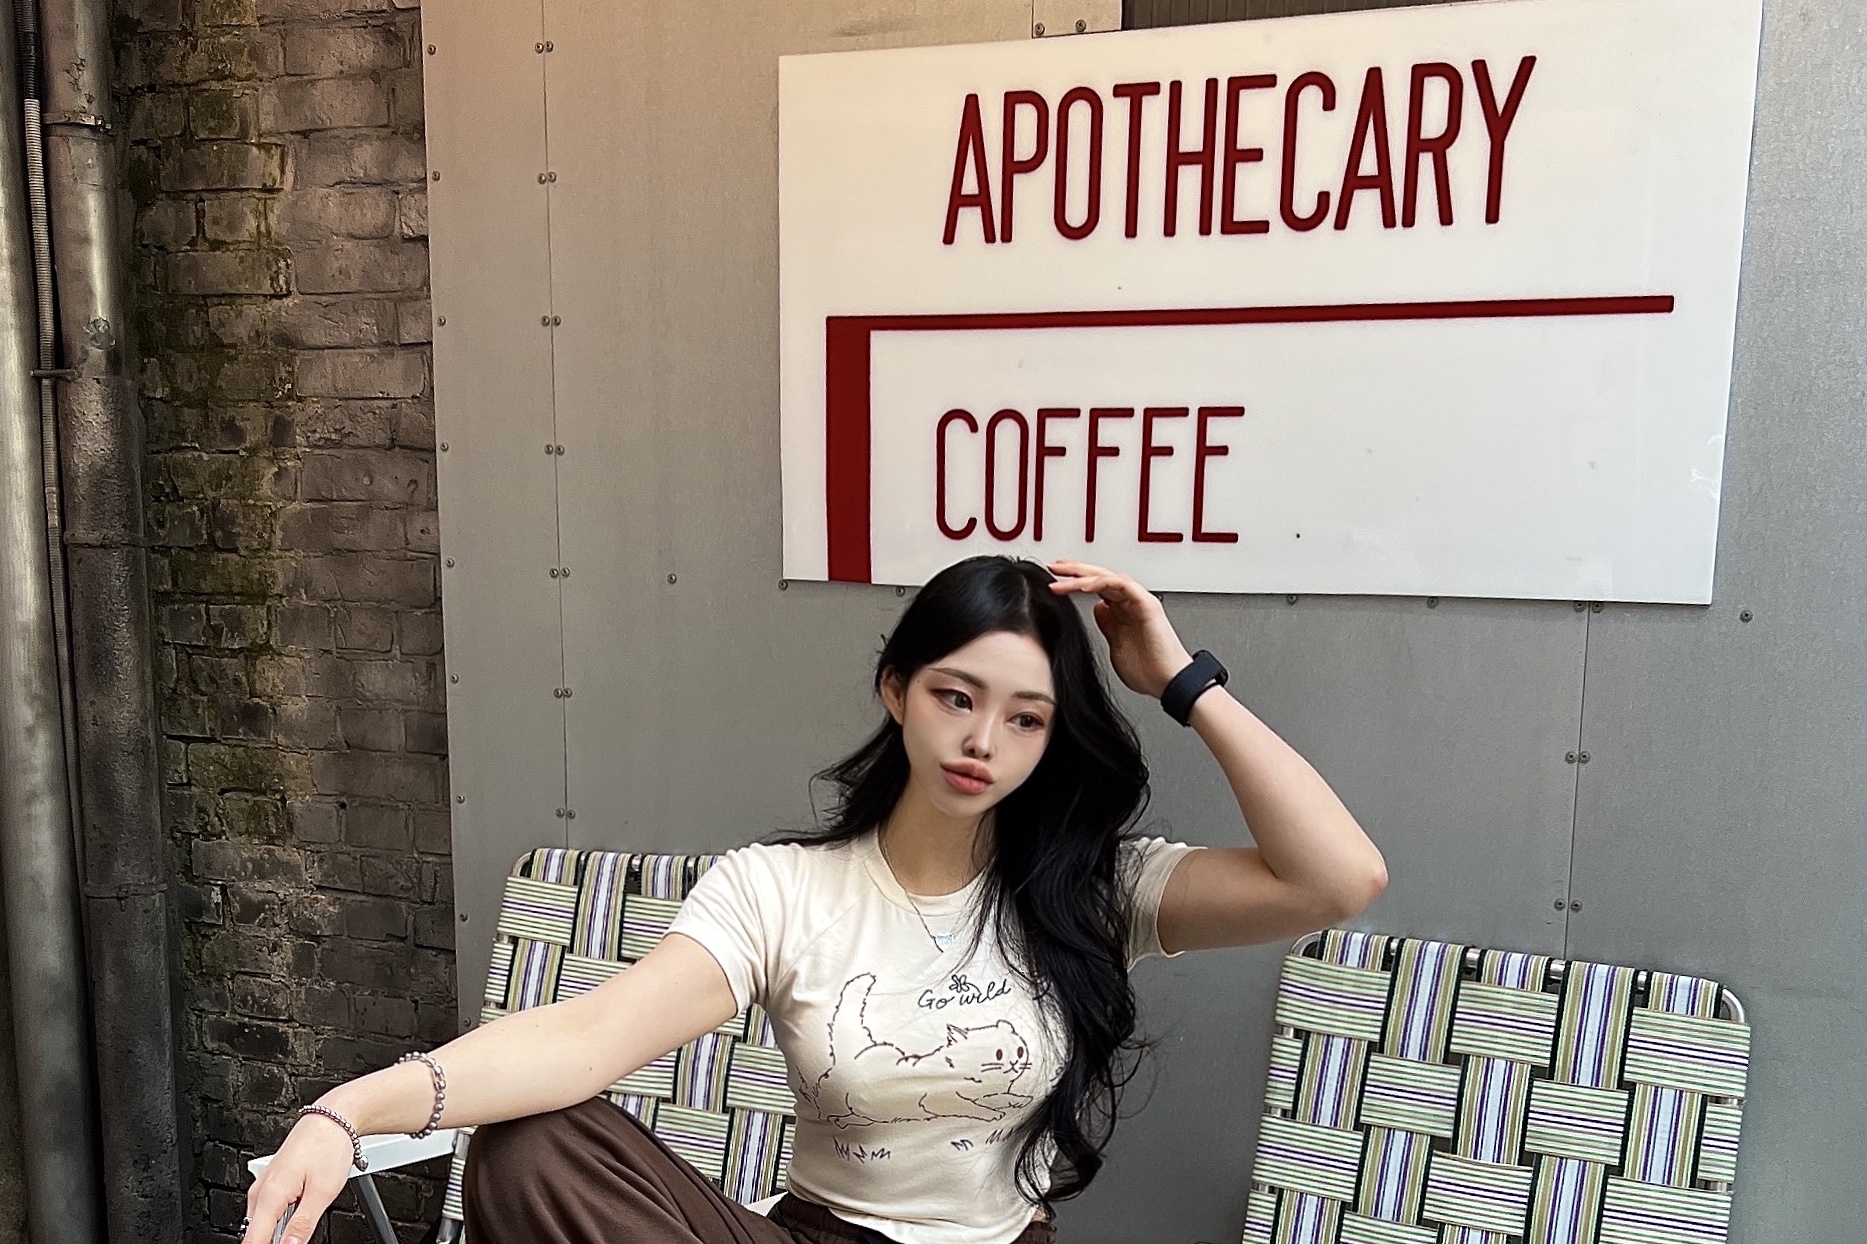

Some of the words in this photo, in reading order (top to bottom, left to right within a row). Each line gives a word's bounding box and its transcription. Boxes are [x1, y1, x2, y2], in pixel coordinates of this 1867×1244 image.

[941, 55, 1538, 246] APOTHECARY
[935, 405, 1246, 545] COFFEE
[917, 988, 955, 1010] Go
[959, 978, 1012, 1005] wild
